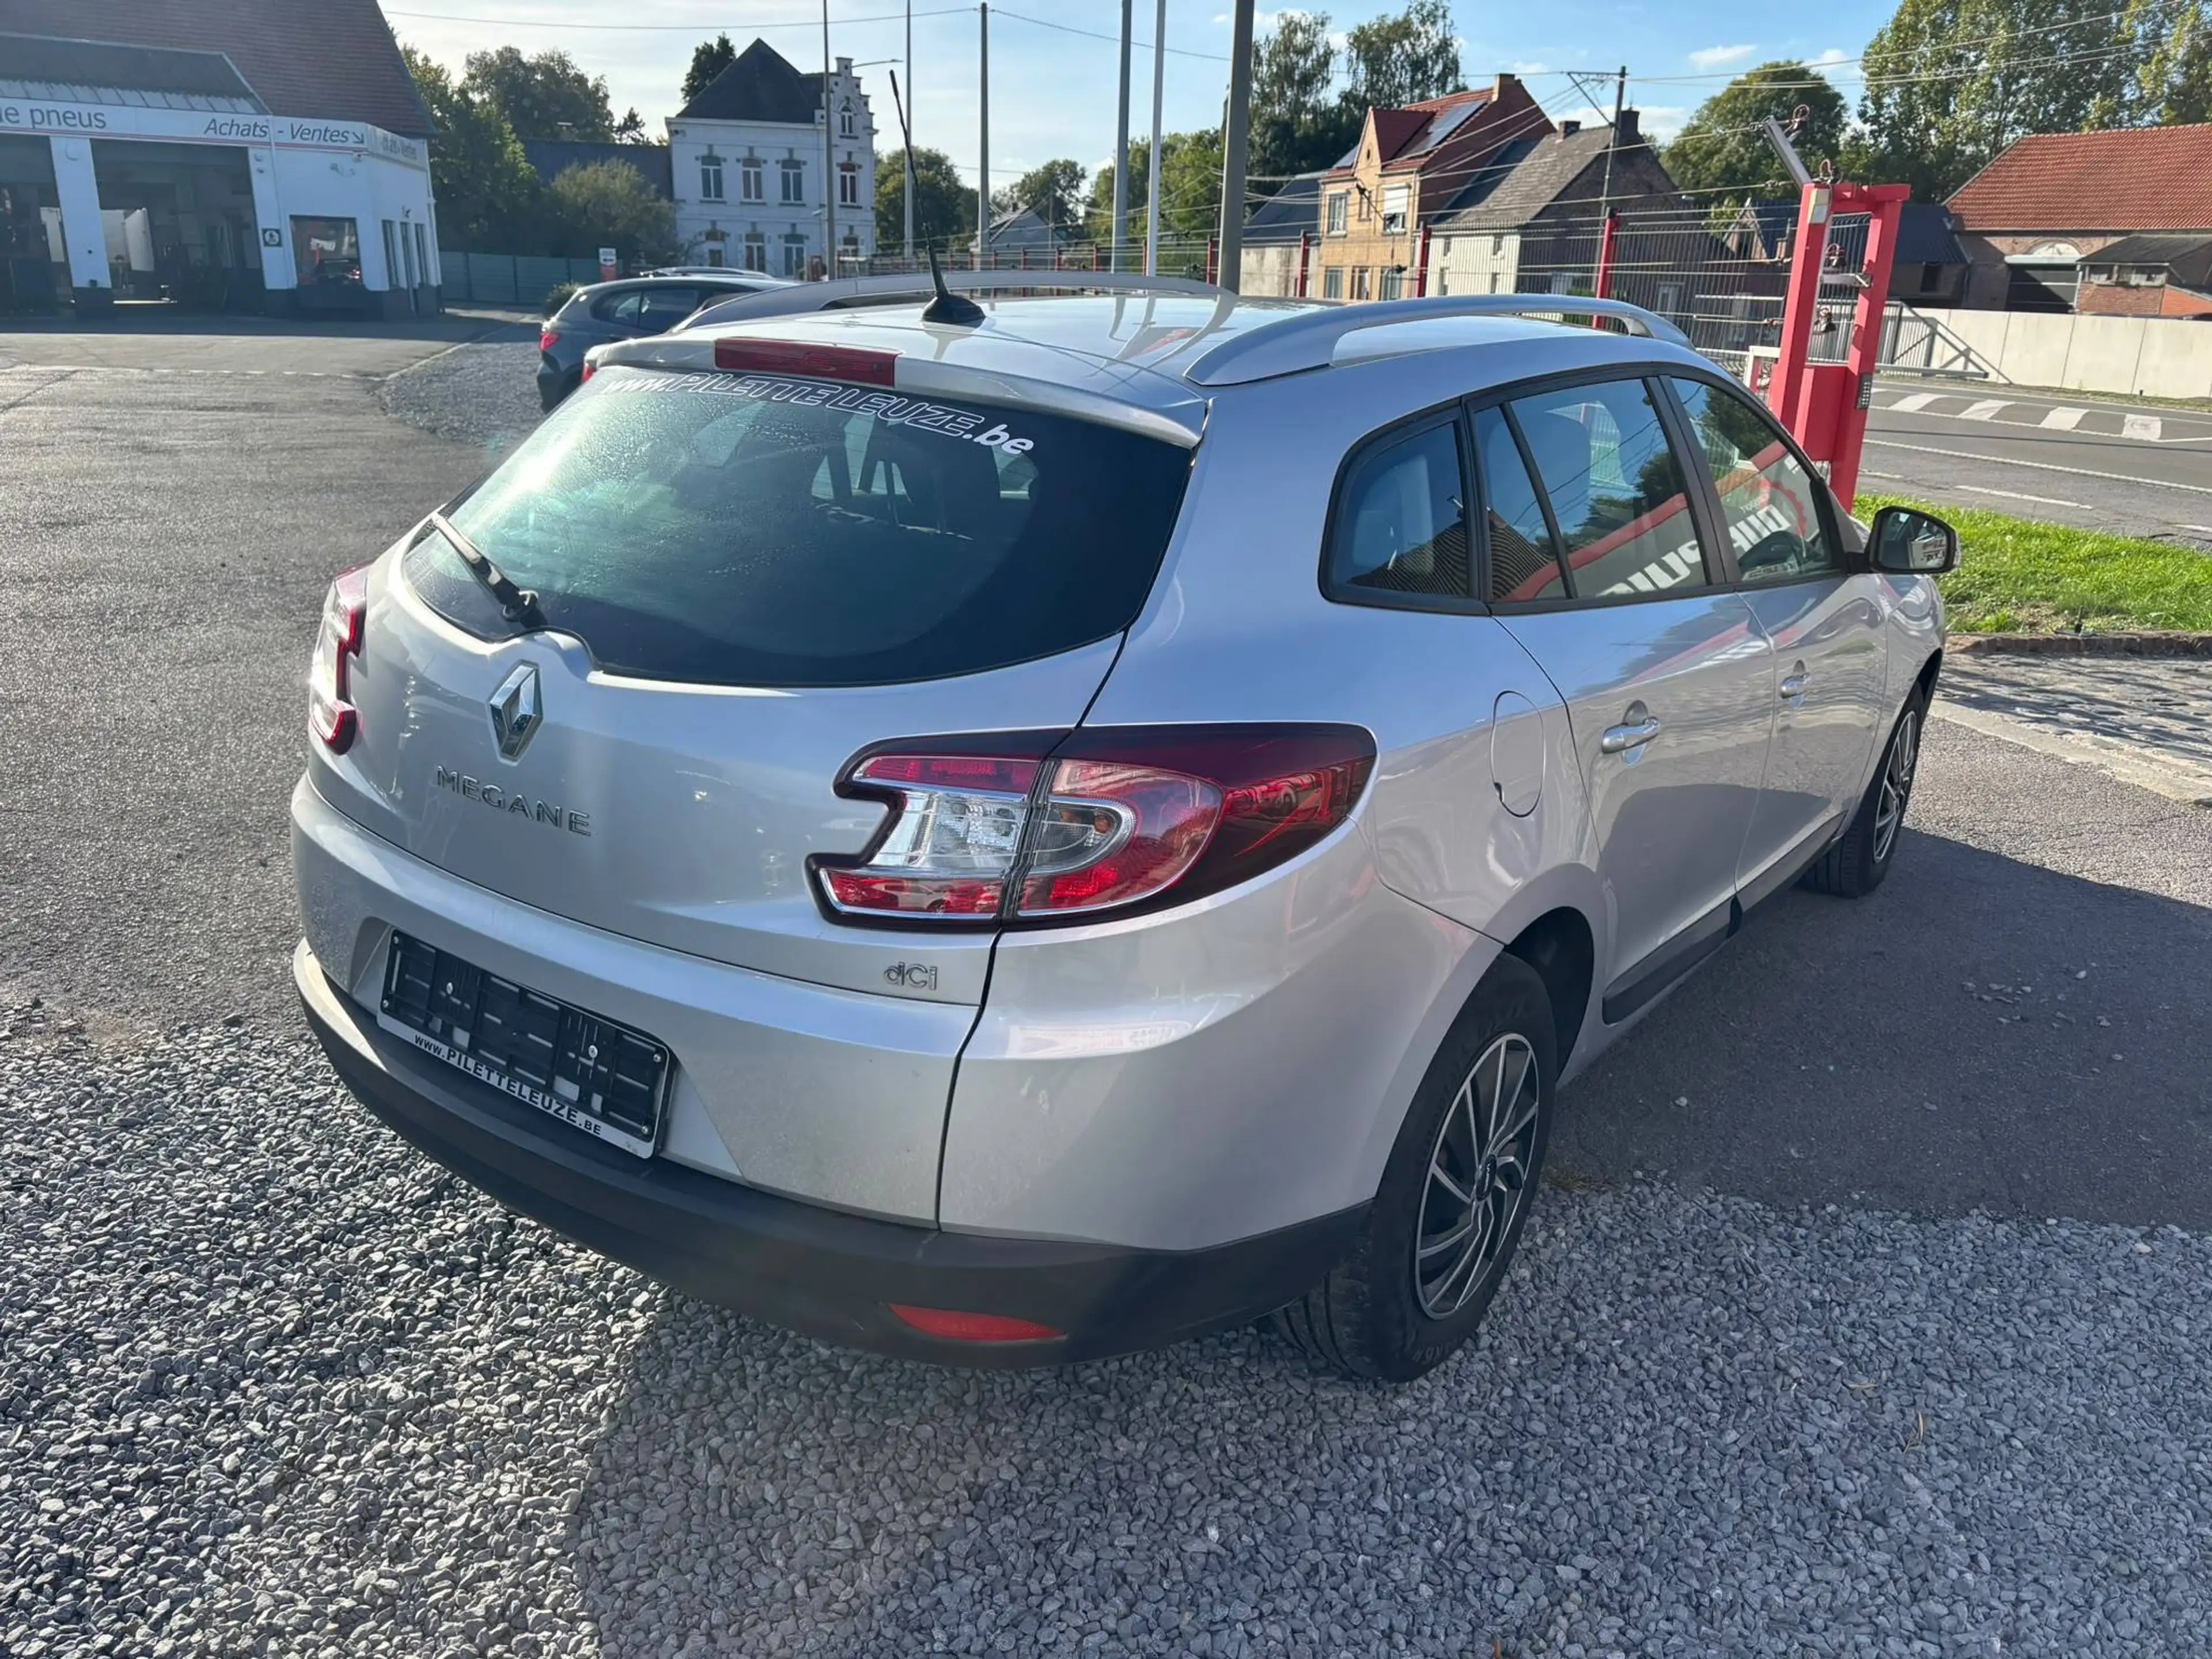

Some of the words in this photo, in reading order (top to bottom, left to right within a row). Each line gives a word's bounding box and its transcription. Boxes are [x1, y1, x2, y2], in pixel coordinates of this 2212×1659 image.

[0, 106, 20, 124] e
[29, 108, 106, 129] pneus
[203, 118, 269, 138] Achats
[290, 123, 350, 143] Ventes
[436, 764, 592, 836] MEGANE
[414, 1034, 603, 1137] www.PILETTELEUZE.BE
